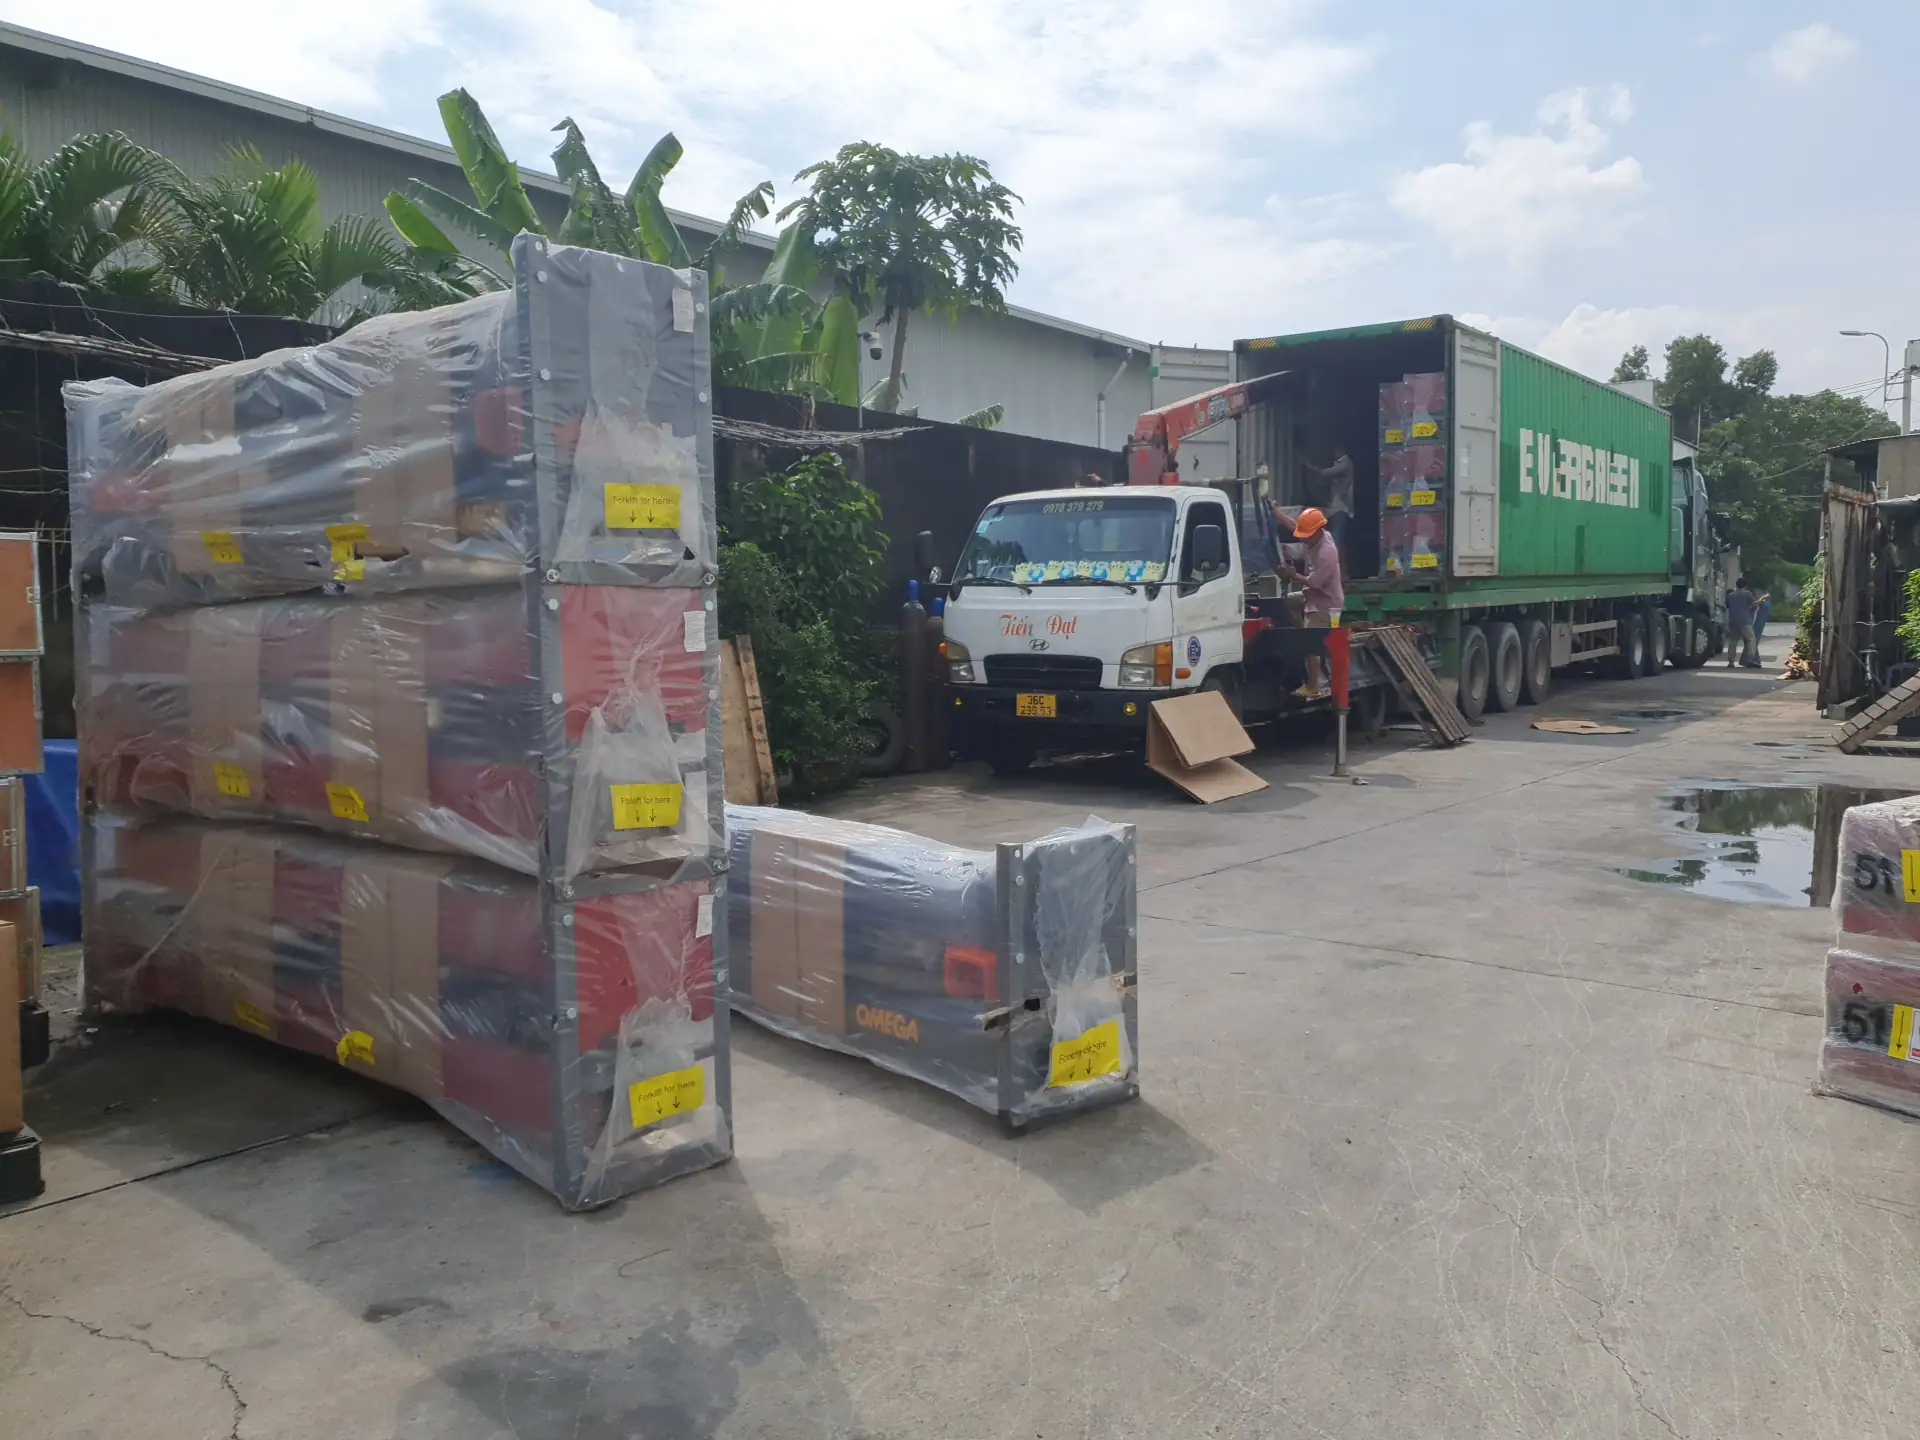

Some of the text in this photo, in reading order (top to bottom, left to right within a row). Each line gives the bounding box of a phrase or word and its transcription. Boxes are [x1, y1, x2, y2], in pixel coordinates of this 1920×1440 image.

[1519, 427, 1640, 509] EVERGREEN
[640, 496, 650, 505] for
[653, 496, 671, 505] here
[1027, 695, 1045, 705] 36C
[643, 796, 653, 805] for
[655, 796, 671, 804] here
[1854, 853, 1895, 896] 51
[856, 1003, 918, 1044] OMEGA
[1842, 1002, 1887, 1045] 51
